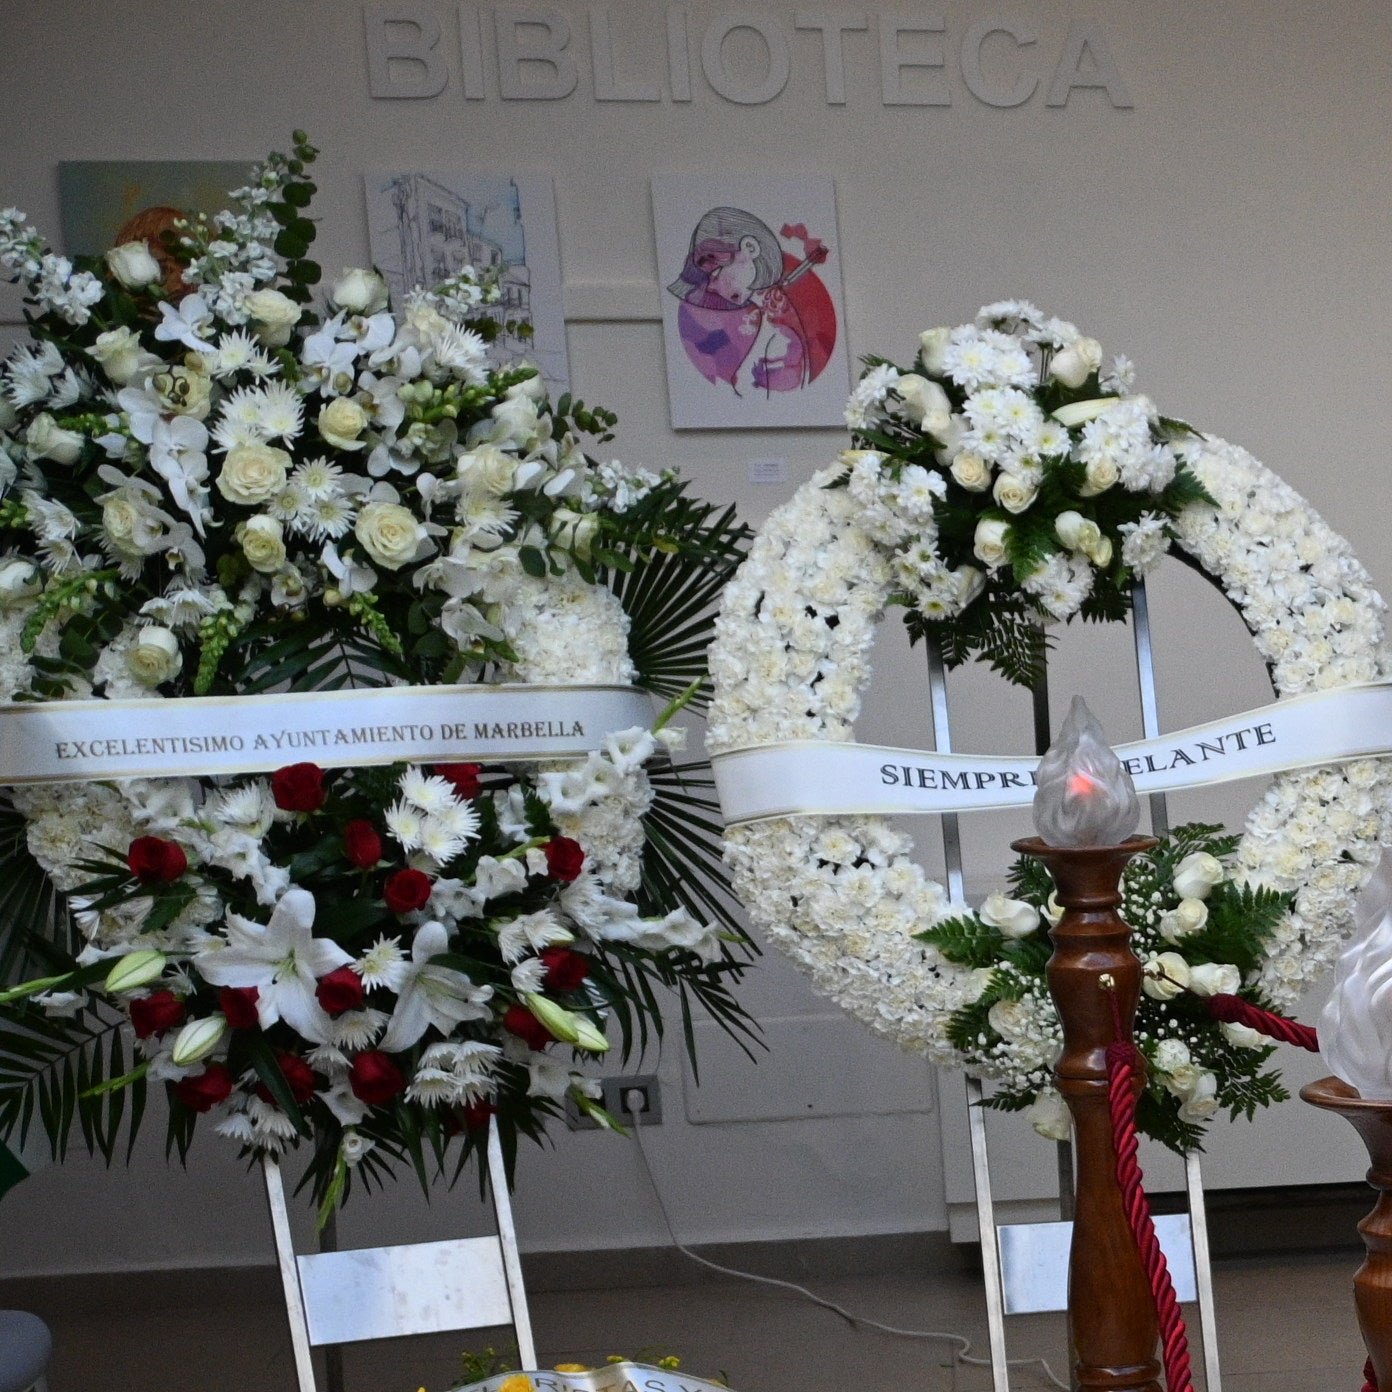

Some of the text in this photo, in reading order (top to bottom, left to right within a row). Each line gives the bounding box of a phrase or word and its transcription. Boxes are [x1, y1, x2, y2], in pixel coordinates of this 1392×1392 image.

[365, 6, 1135, 110] BIBLIOTECA
[55, 720, 585, 760] EXCELENTISIMO AYUNTAMIENTO DE MARBELLA
[1121, 722, 1277, 777] ELANTE
